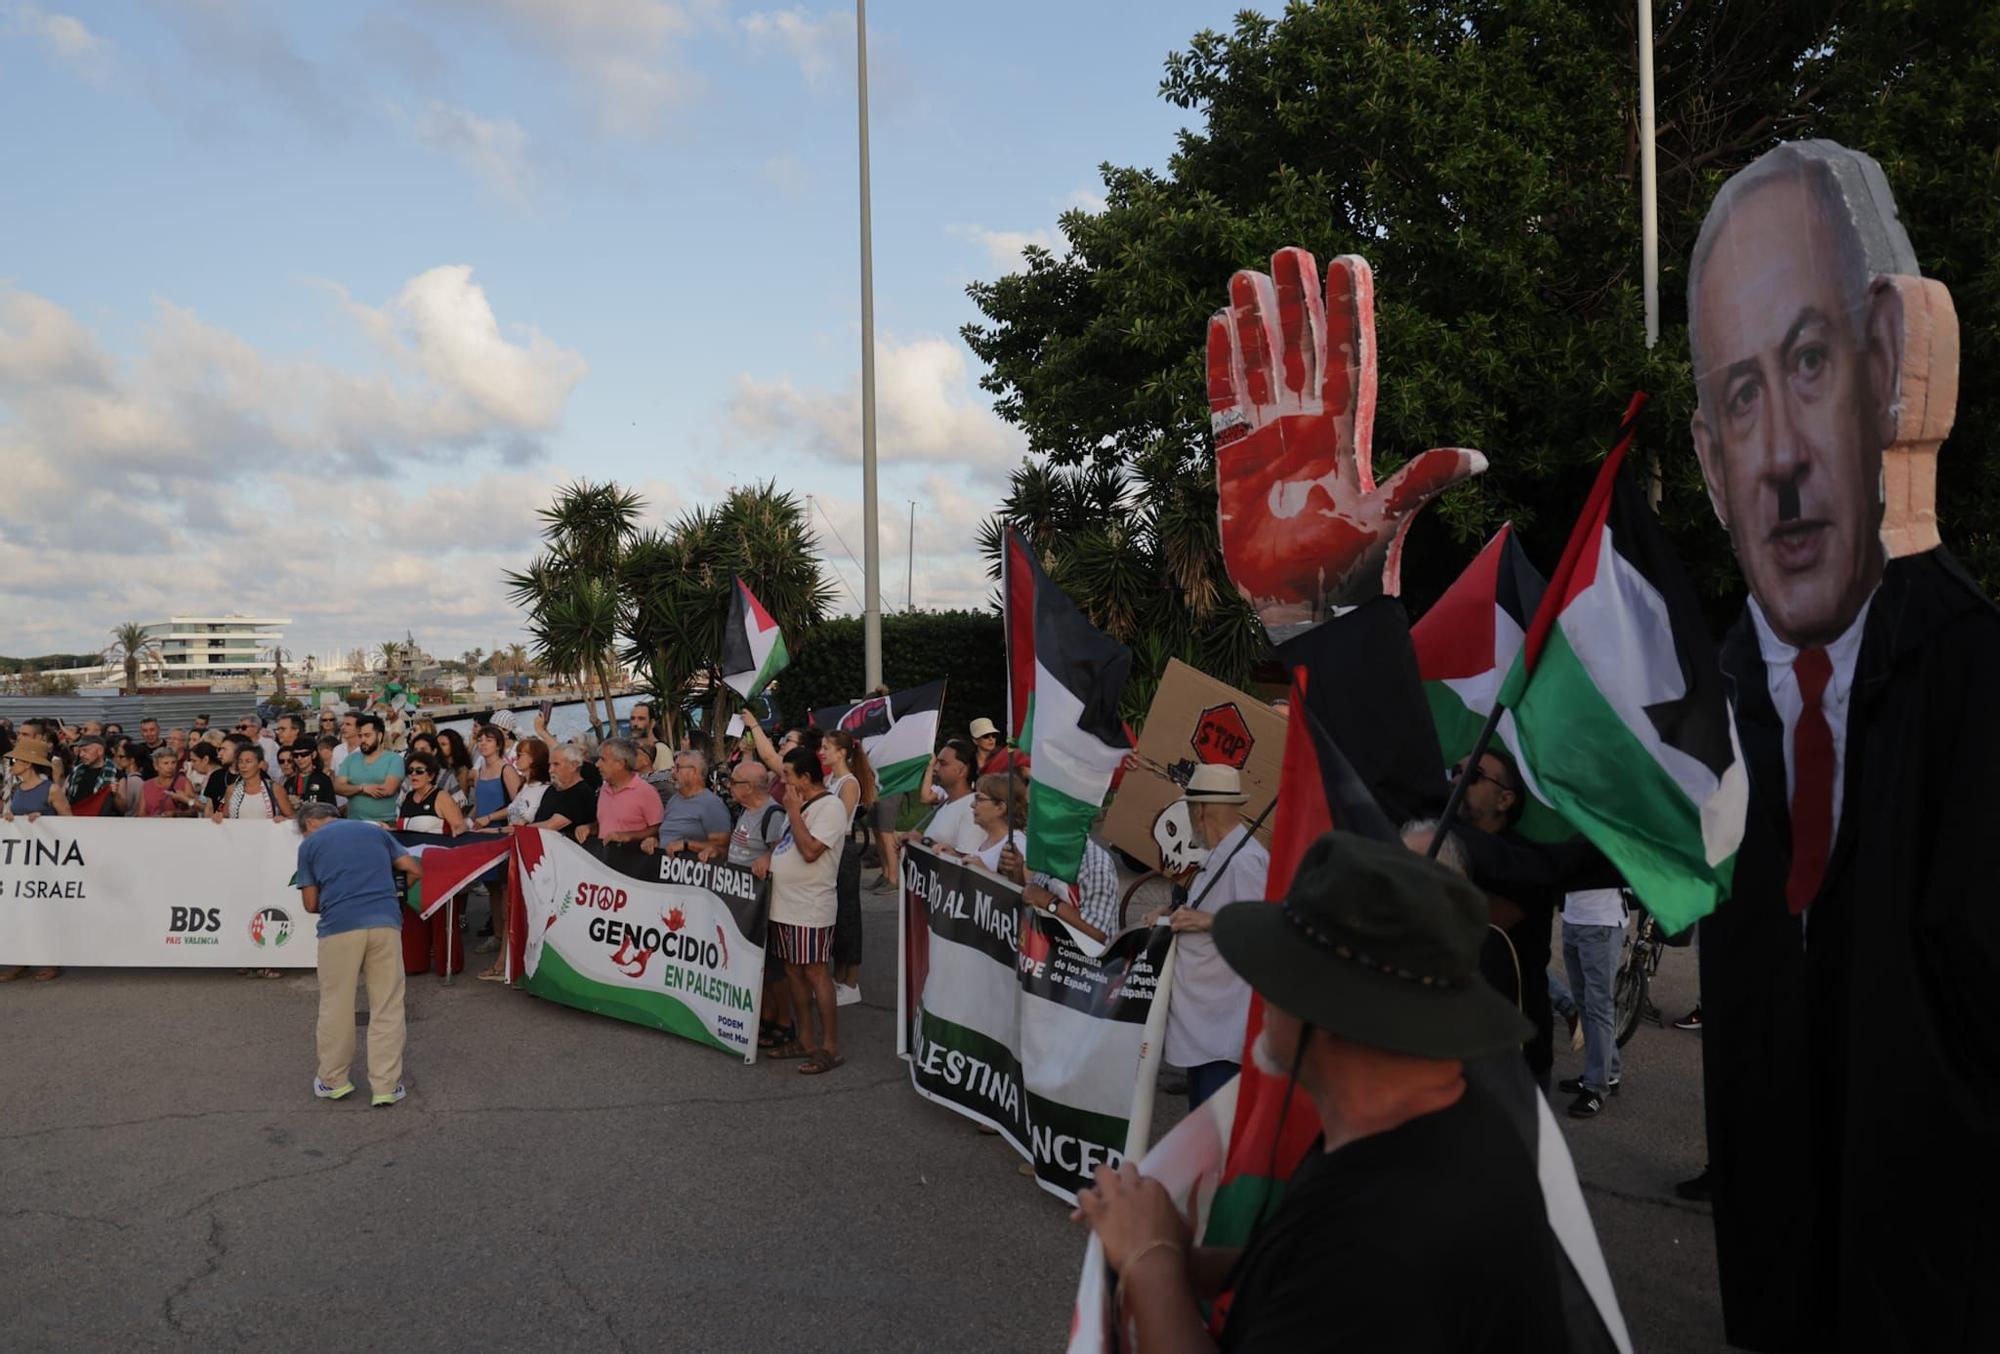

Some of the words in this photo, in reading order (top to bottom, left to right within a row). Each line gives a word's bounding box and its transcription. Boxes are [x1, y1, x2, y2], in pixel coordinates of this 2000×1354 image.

[1199, 721, 1246, 759] STOP
[14, 880, 86, 899] ISRAEL
[659, 855, 711, 888] BOICOT
[711, 865, 756, 901] ISRAEL
[574, 882, 628, 913] STOP
[943, 890, 970, 919] AL
[169, 906, 221, 932] BDS
[588, 917, 719, 969] GENOCIDIO
[1054, 959, 1066, 970] de
[1066, 962, 1080, 975] los
[664, 965, 684, 990] EN
[686, 970, 753, 1013] PALESTINA
[1050, 972, 1062, 983] de
[1063, 976, 1092, 993] España
[718, 1015, 744, 1030] PODEM
[718, 1028, 733, 1041] Sant
